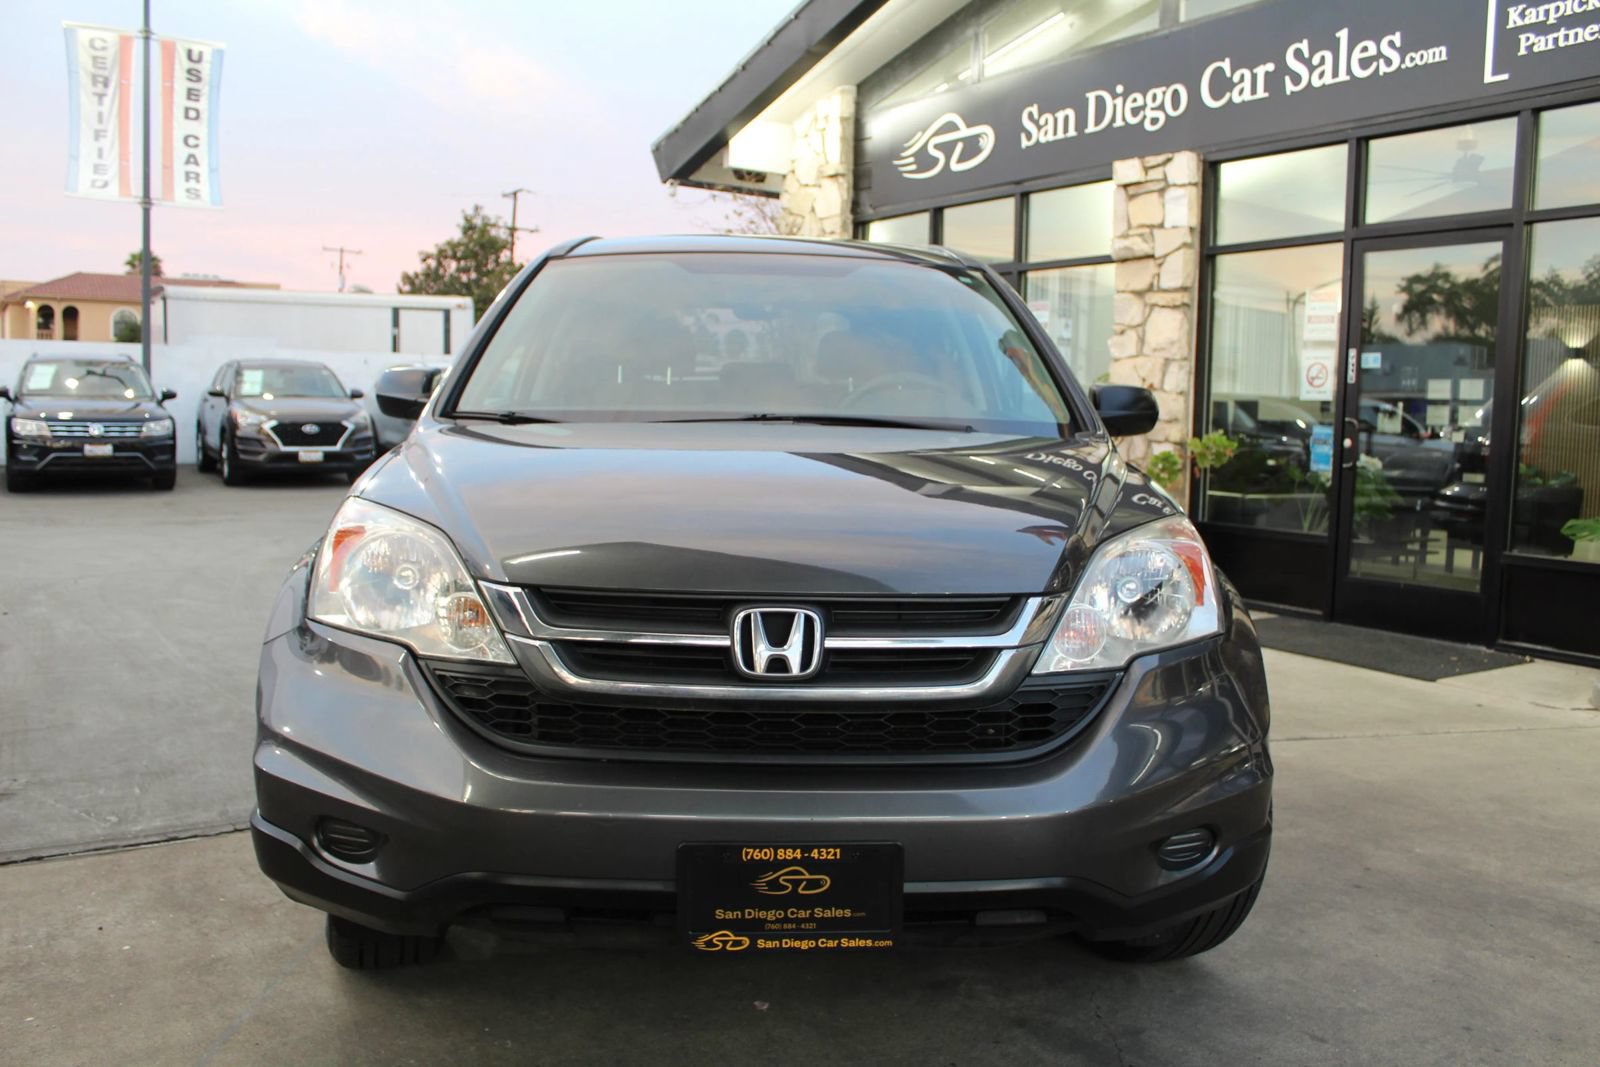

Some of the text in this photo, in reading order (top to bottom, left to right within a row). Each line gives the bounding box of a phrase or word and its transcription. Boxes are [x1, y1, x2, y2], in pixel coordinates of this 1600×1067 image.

[1517, 24, 1600, 56] Partne
[1020, 27, 1447, 149] San Diego Car Sales.com
[88, 37, 109, 189] CERTIFIED
[183, 48, 203, 200] USED CARS
[742, 847, 774, 861] (760)
[777, 848, 801, 860] 884
[811, 848, 841, 859] 4321
[715, 909, 741, 919] San
[745, 908, 784, 920] Diego
[787, 908, 811, 918] Car
[757, 937, 893, 950] San Diego Car Sales.com
